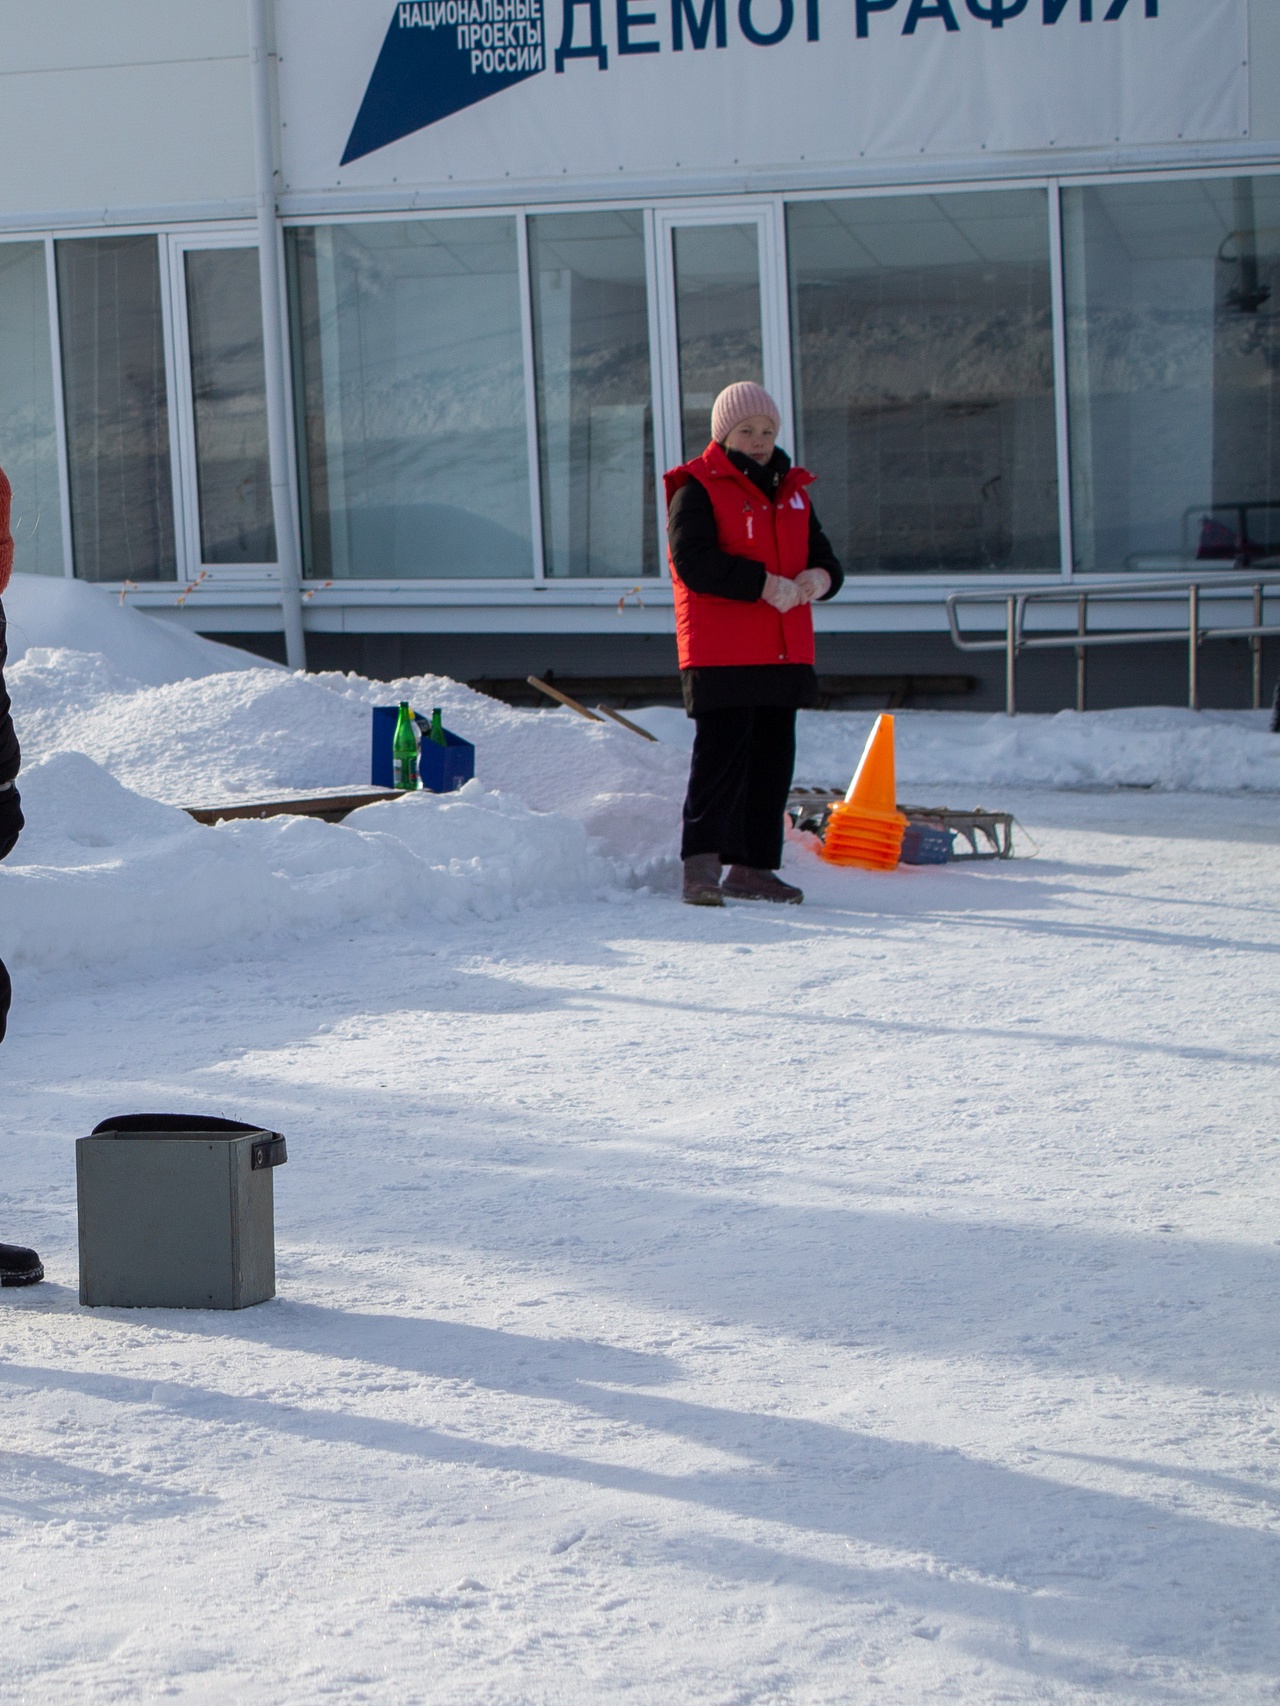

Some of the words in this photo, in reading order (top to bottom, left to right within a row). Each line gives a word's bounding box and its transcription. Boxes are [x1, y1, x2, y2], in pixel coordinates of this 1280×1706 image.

[399, 0, 541, 30] НАЦИОНАЛЬНЫЕ
[457, 20, 542, 50] ПРОЕКТЫ
[472, 46, 543, 74] РОССИИ
